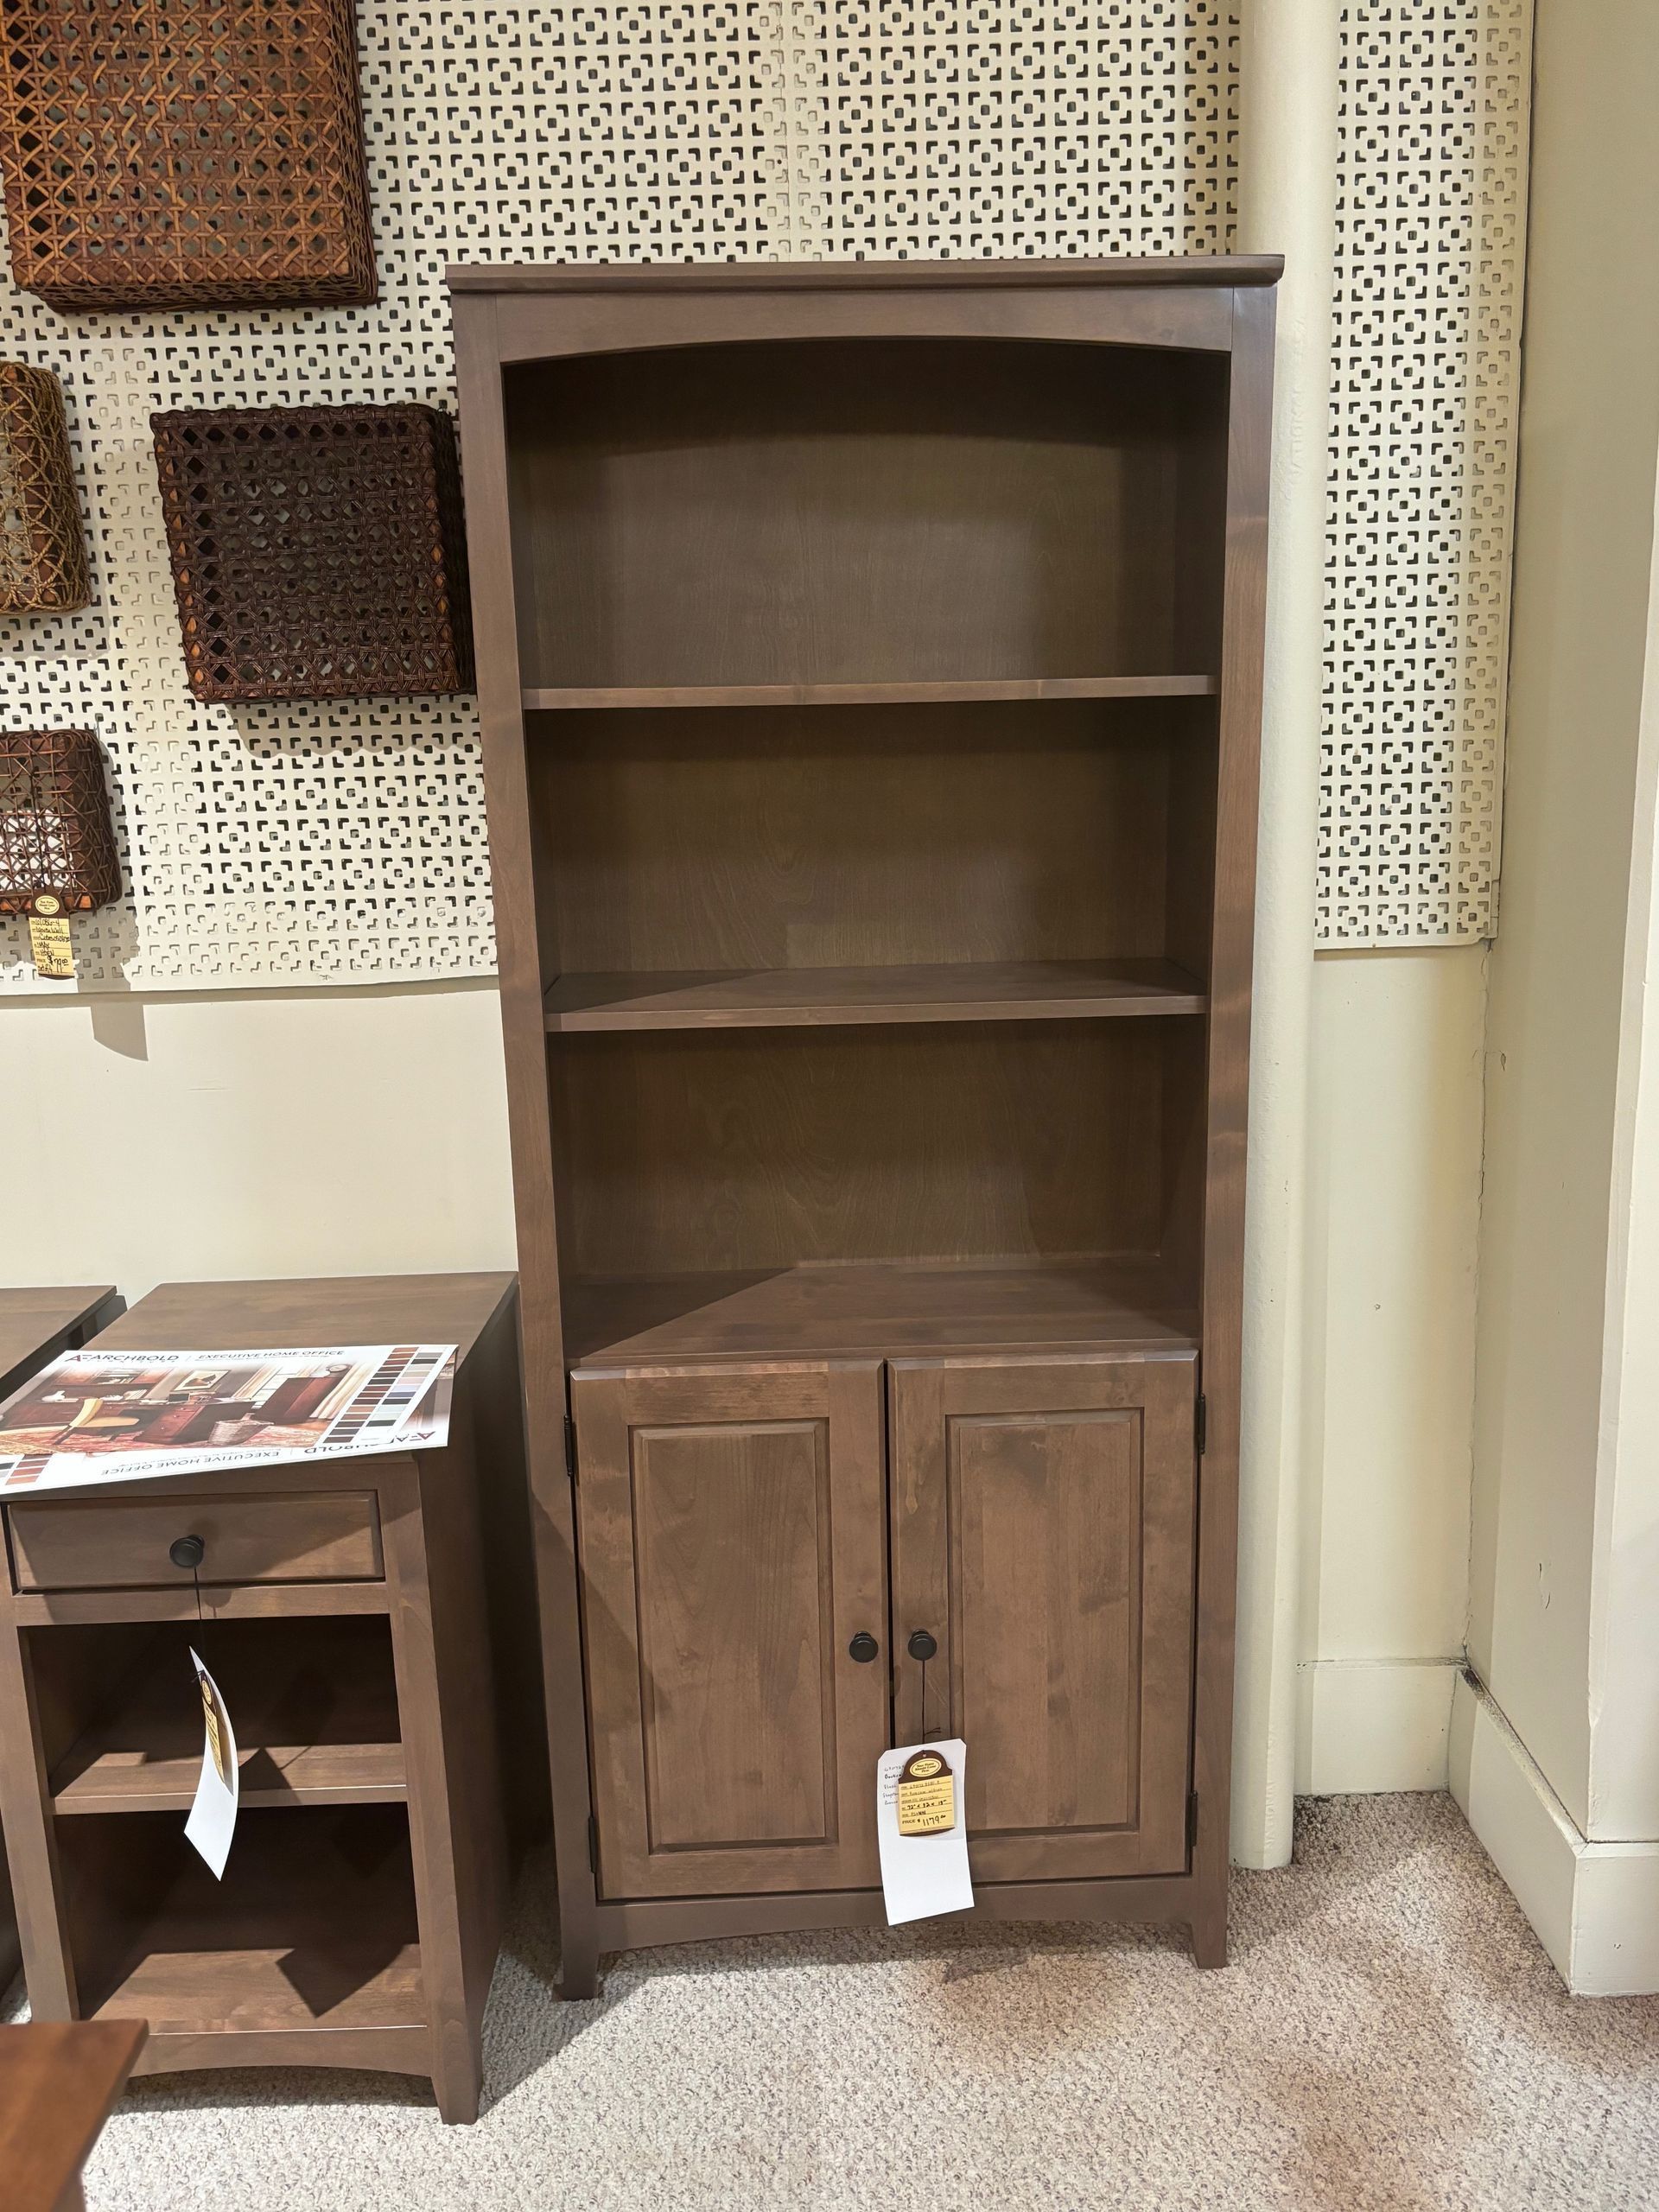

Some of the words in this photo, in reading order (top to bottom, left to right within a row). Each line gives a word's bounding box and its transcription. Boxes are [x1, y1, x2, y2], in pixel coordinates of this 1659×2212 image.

[89, 1353, 179, 1363] ARCHBOLD
[204, 1451, 279, 1463] EXECUTIVE
[156, 1459, 200, 1468] HOME
[101, 1464, 152, 1476] OFFICE
